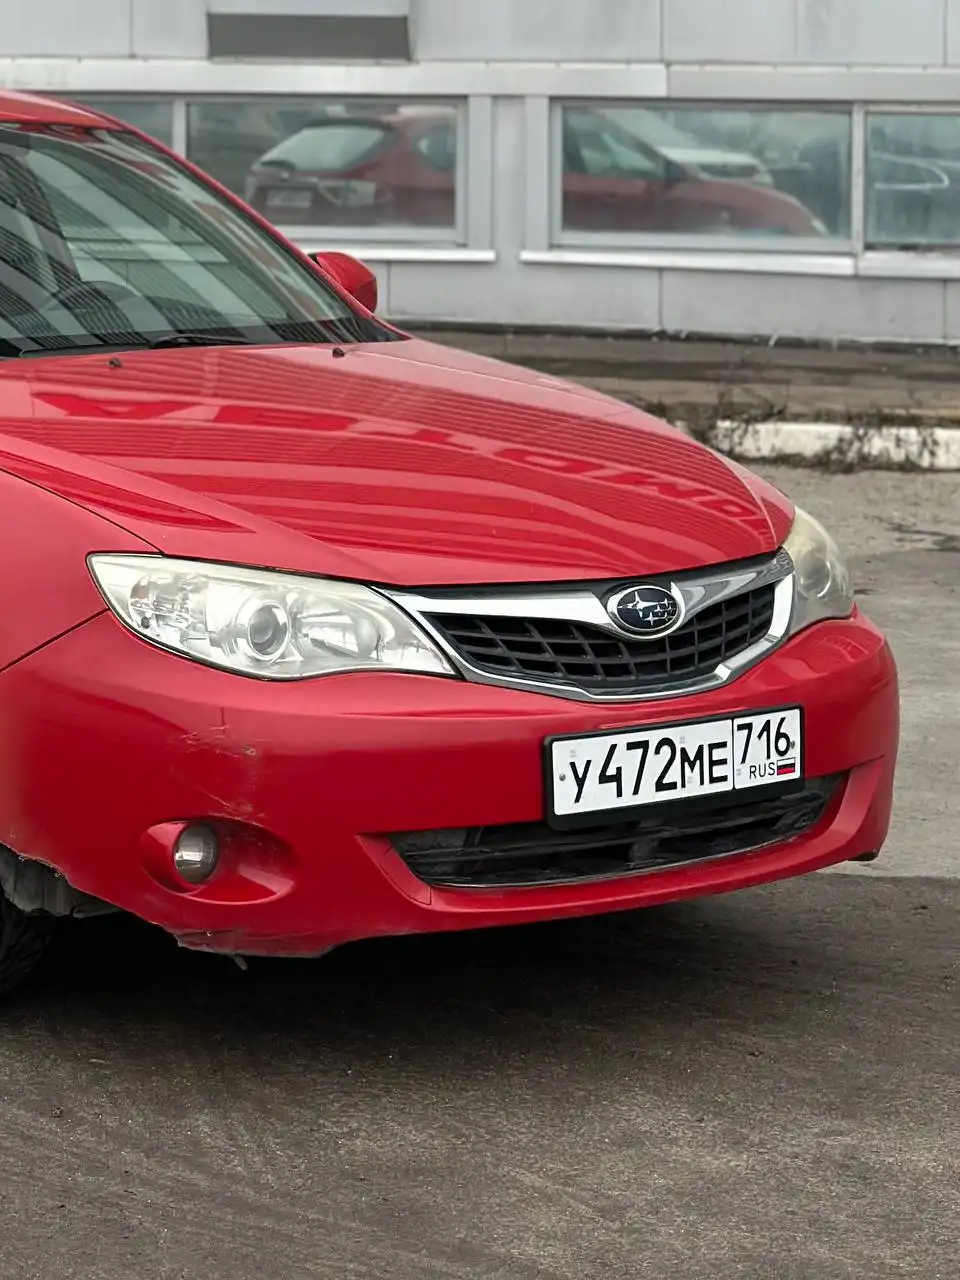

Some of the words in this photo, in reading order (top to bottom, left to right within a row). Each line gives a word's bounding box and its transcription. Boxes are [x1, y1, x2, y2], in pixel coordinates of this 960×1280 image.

[569, 738, 729, 803] У472МЕ
[736, 717, 791, 765] 716
[749, 761, 776, 780] RUS
